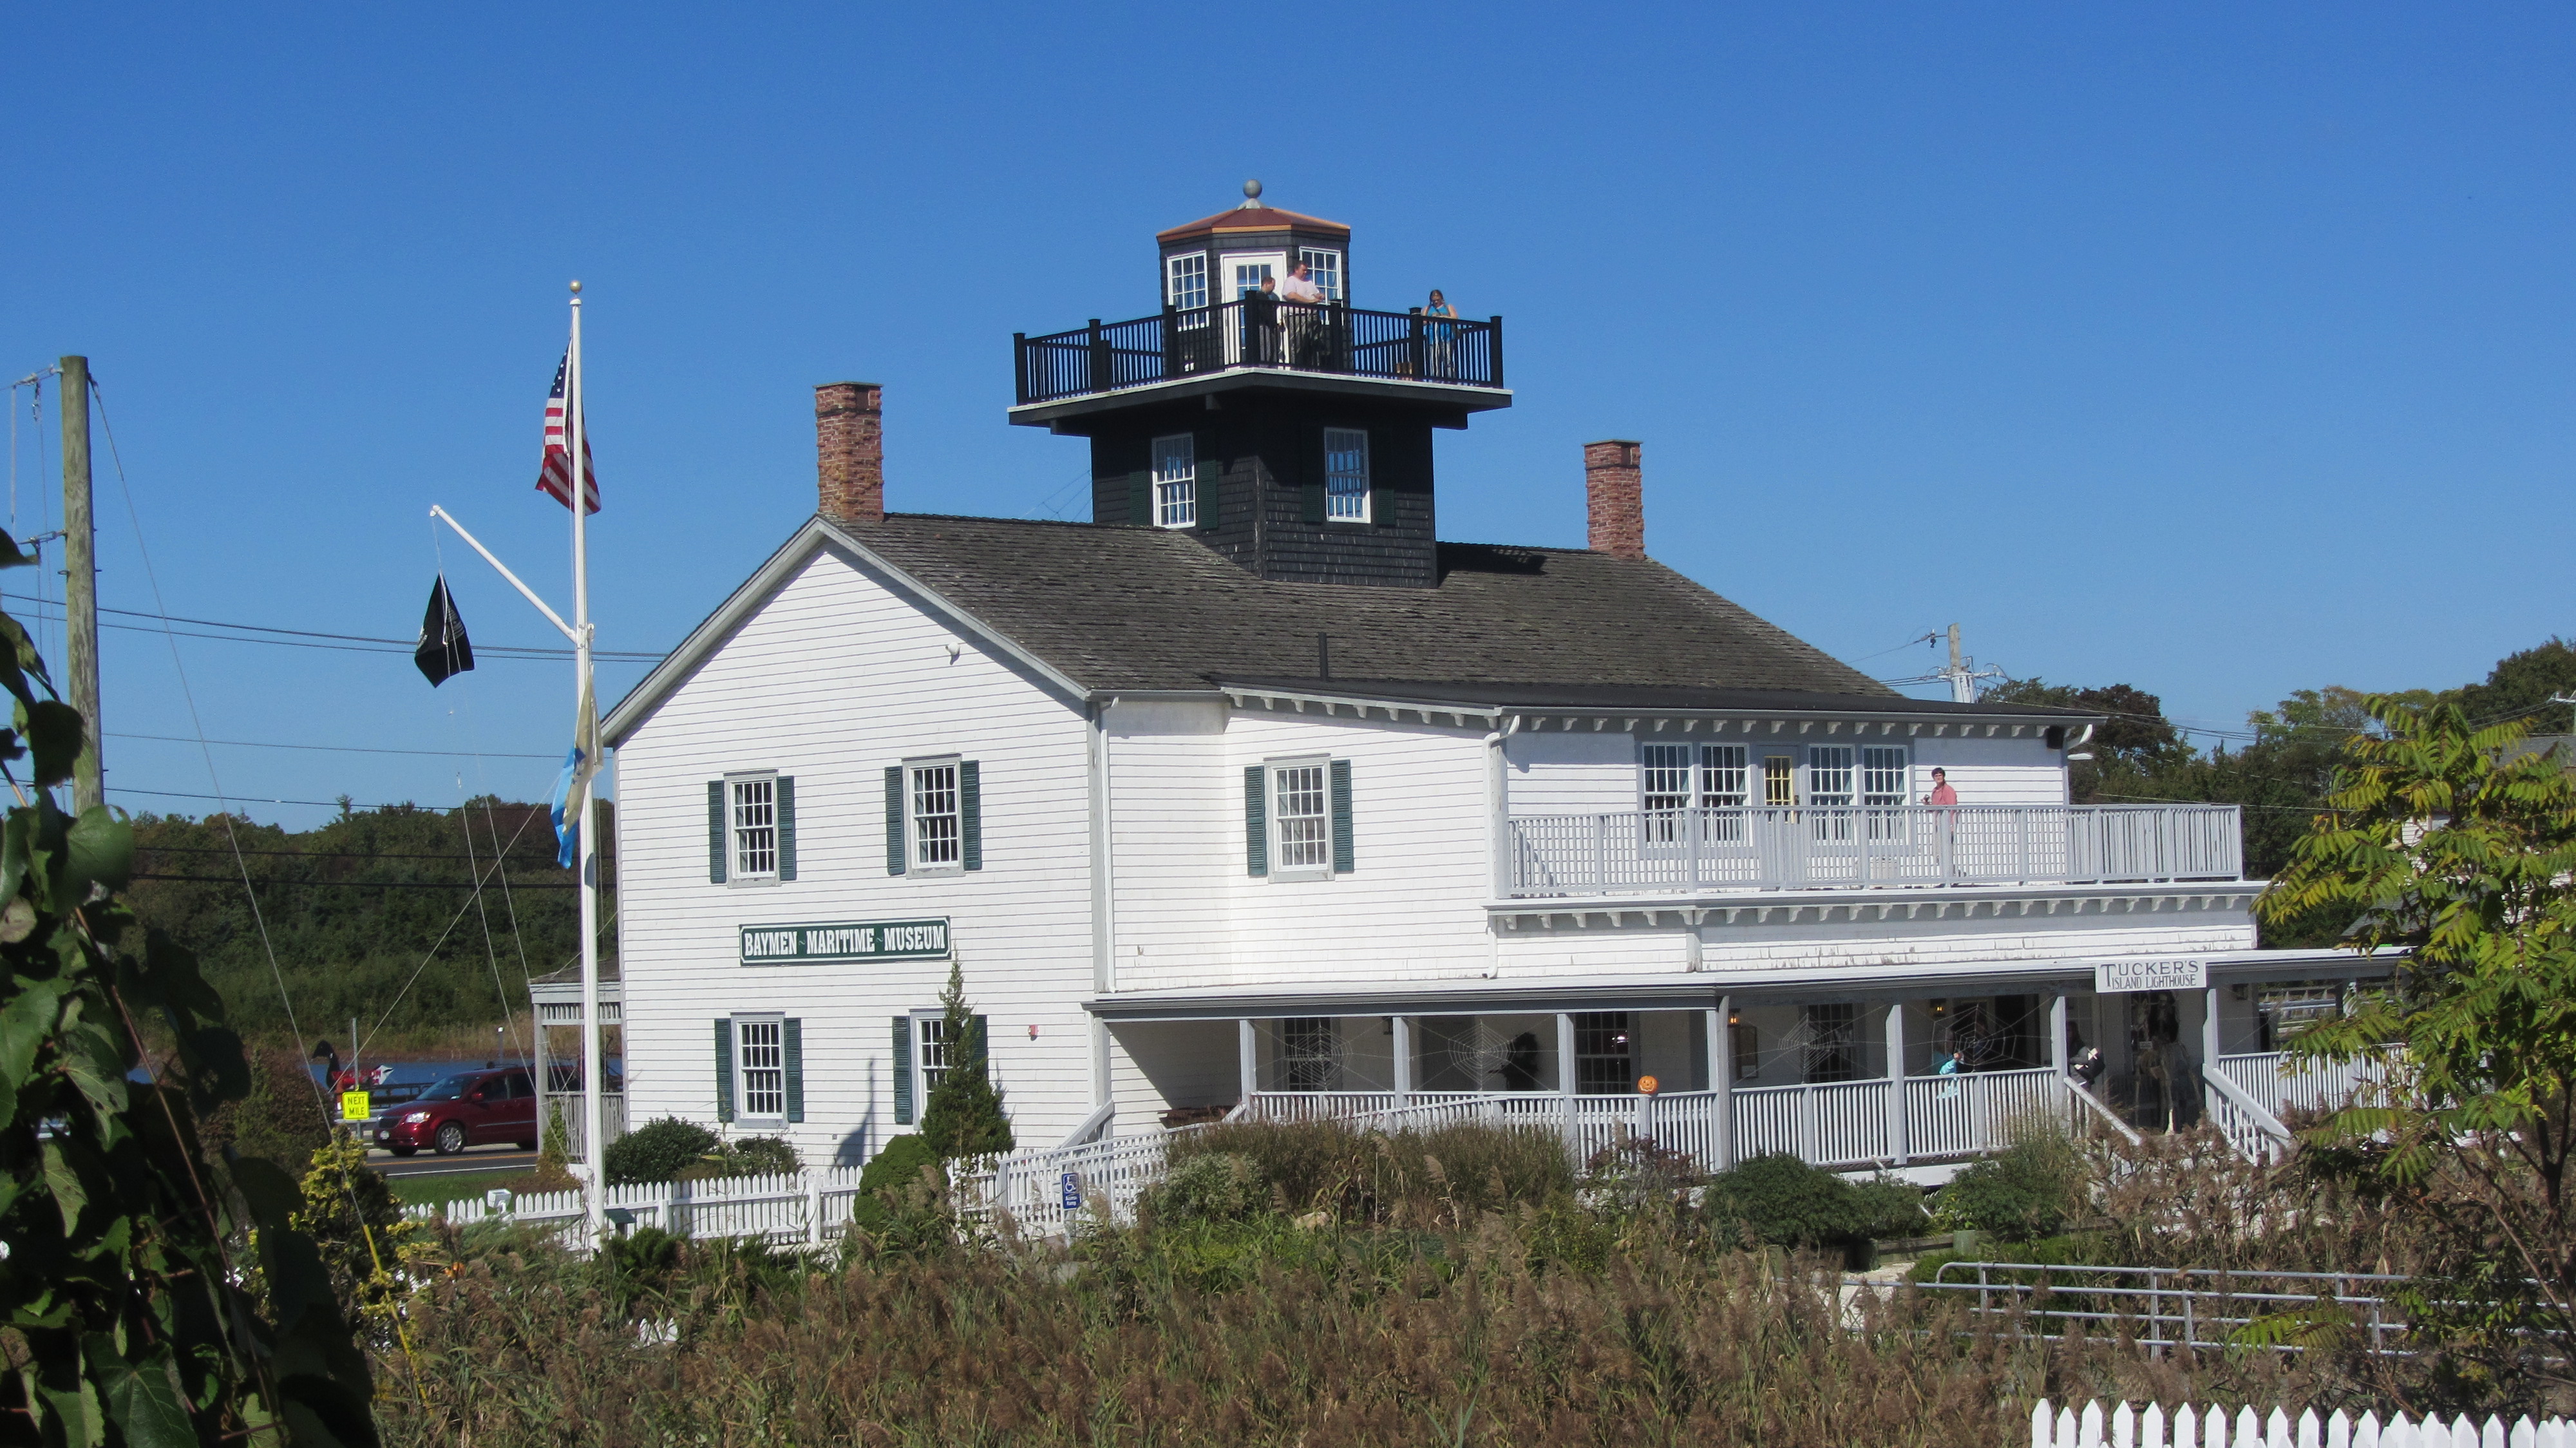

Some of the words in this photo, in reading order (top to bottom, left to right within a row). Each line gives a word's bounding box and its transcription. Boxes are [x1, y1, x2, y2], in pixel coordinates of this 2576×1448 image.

[744, 931, 797, 956] BAYMEN
[806, 928, 875, 954] MARITIME
[884, 926, 945, 951] MUSEUM
[2101, 961, 2198, 987] TUCKER'S
[2112, 976, 2142, 989] ISLAND
[2146, 974, 2196, 988] LIGHTHOUSE
[349, 1107, 365, 1116] MILE
